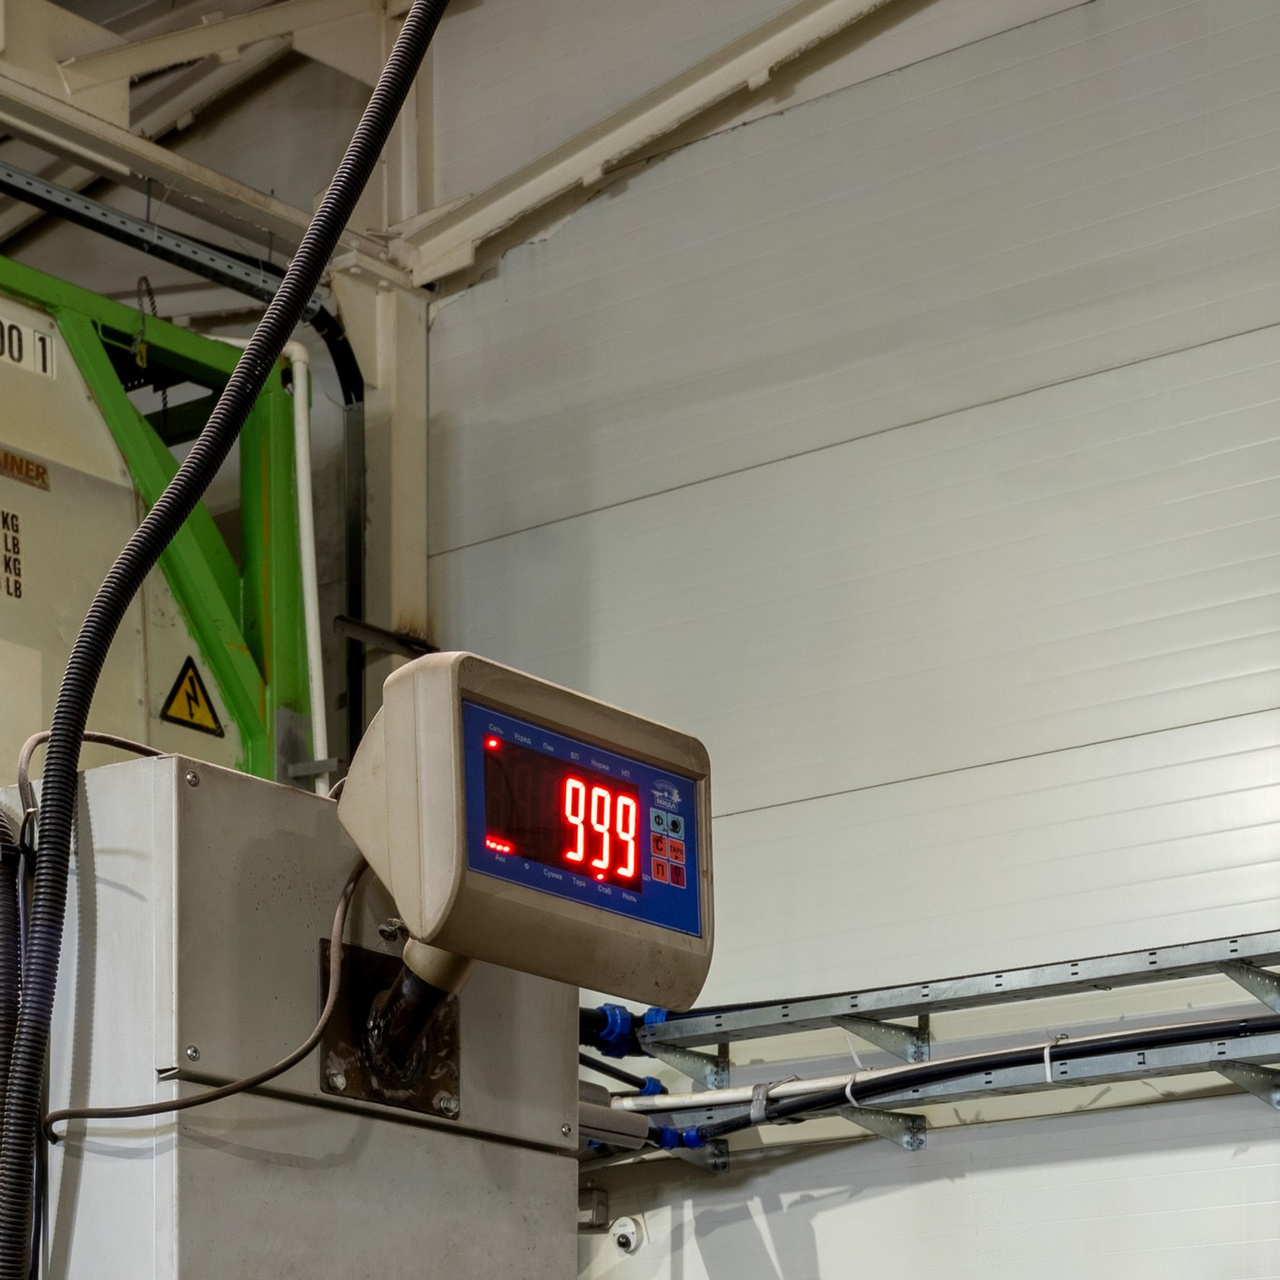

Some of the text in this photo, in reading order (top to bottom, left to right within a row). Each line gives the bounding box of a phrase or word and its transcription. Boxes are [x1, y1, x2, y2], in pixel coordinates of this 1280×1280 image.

[0, 452, 47, 484] INER
[2, 510, 19, 534] KG
[4, 533, 20, 555] LB
[4, 554, 21, 577] KG
[6, 576, 22, 599] LB
[488, 723, 504, 735] Сеть
[590, 758, 610, 771] Норма
[565, 778, 636, 878] 999
[543, 868, 563, 881] Сумма
[572, 877, 586, 888] Тара
[598, 884, 612, 896] Стаб
[622, 892, 637, 903] Ноль
